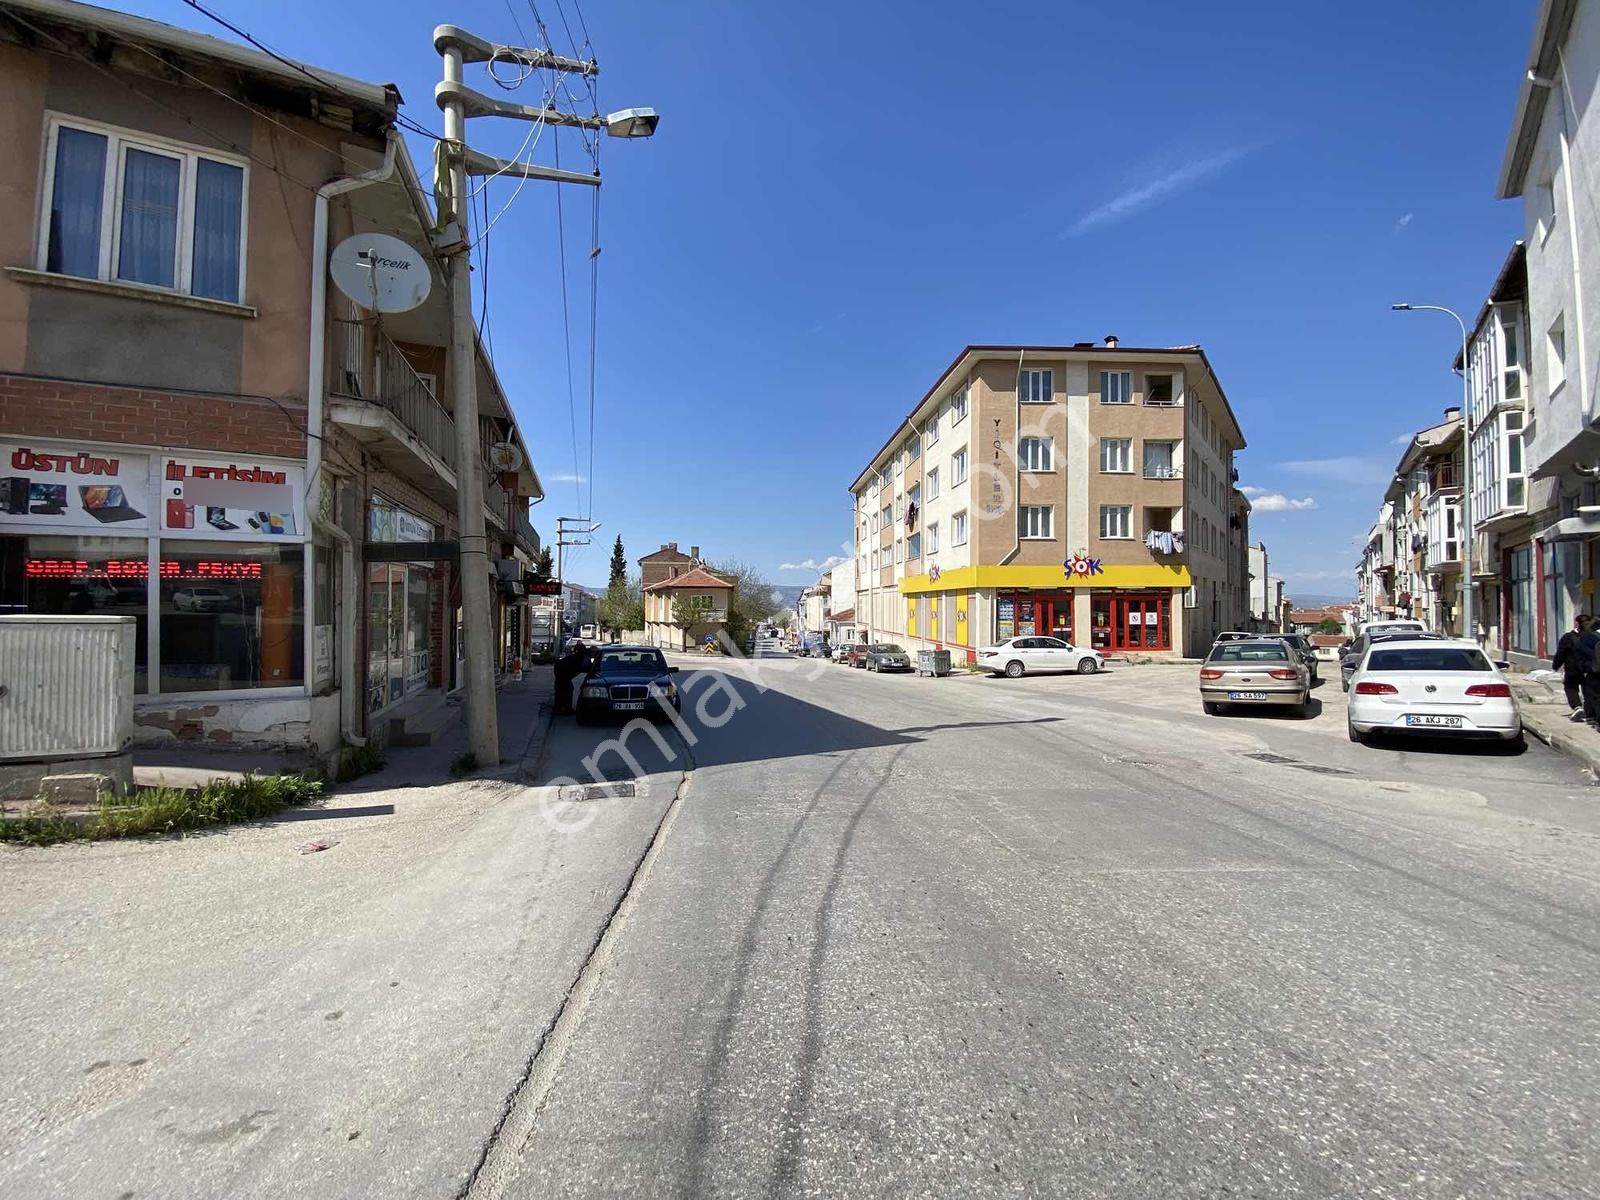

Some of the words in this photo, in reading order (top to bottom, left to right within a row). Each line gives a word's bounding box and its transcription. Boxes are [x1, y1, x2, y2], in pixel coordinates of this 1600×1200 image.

[370, 255, 412, 270] rçelik
[11, 447, 120, 477] ÜSTÜN
[1426, 716, 1441, 724] AKJ
